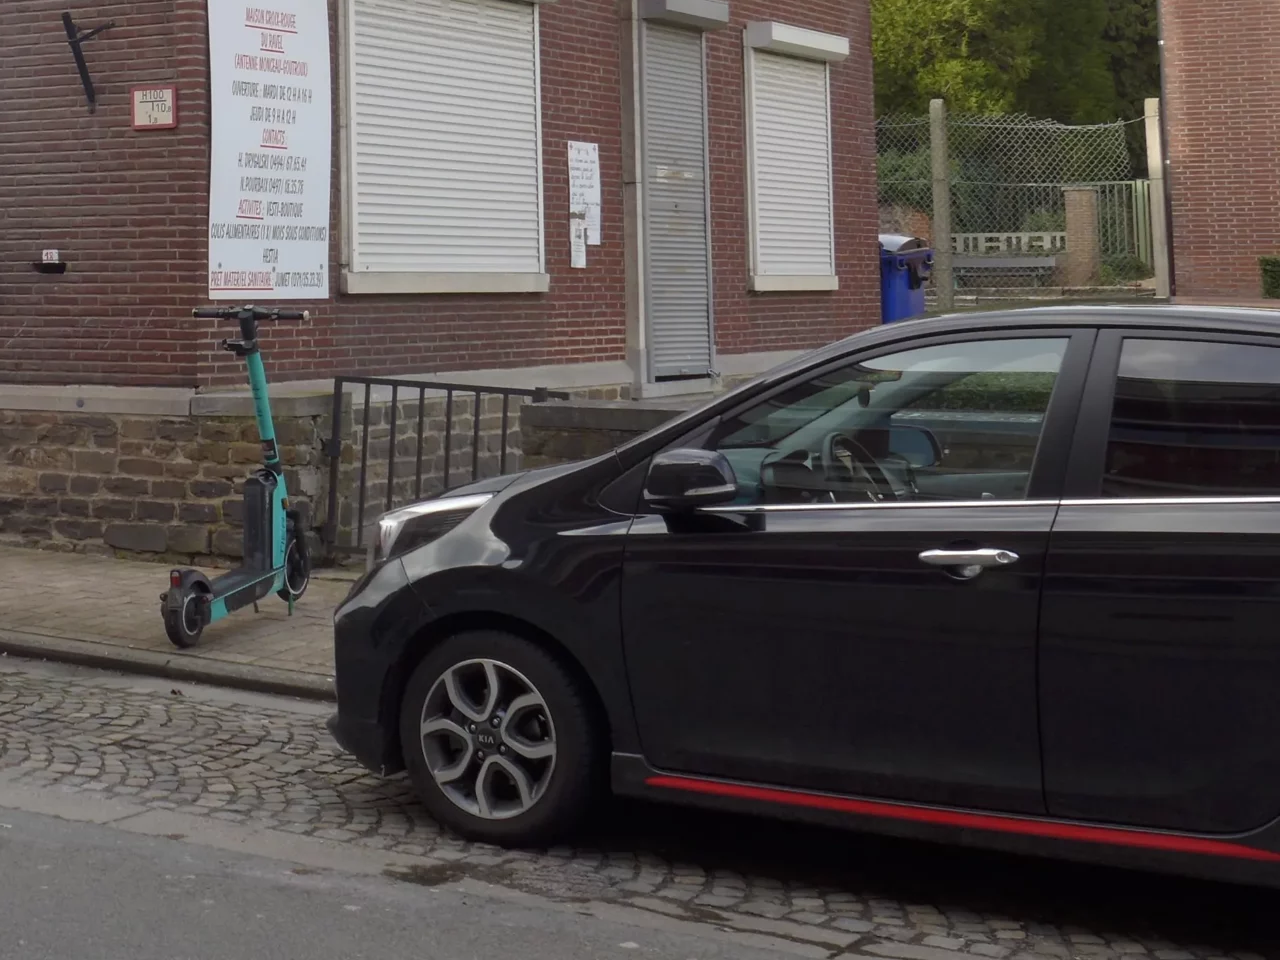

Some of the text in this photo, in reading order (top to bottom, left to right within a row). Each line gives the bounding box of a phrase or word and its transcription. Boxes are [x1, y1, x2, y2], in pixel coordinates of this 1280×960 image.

[246, 7, 297, 29] MAISON CROIX-ROUGE
[261, 33, 283, 49] DU RAVEL
[142, 90, 164, 100] H100
[263, 83, 279, 100] MARDI
[279, 85, 286, 101] DE
[286, 86, 292, 102] 12
[249, 106, 264, 122] JEUDI
[265, 107, 272, 123] DE
[266, 201, 303, 218] VESTI-BOUTIQUE
[211, 223, 225, 239] COLIS
[226, 223, 260, 240] ALIMENTAIRES
[272, 225, 285, 241] MOIS
[285, 226, 298, 241] SOUS
[262, 248, 279, 264] HESTIA
[210, 271, 223, 287] PRET
[223, 271, 247, 287] MATERIEL
[247, 271, 271, 287] SANITAIRE
[274, 272, 291, 287] JUMET
[478, 735, 494, 744] KIA
